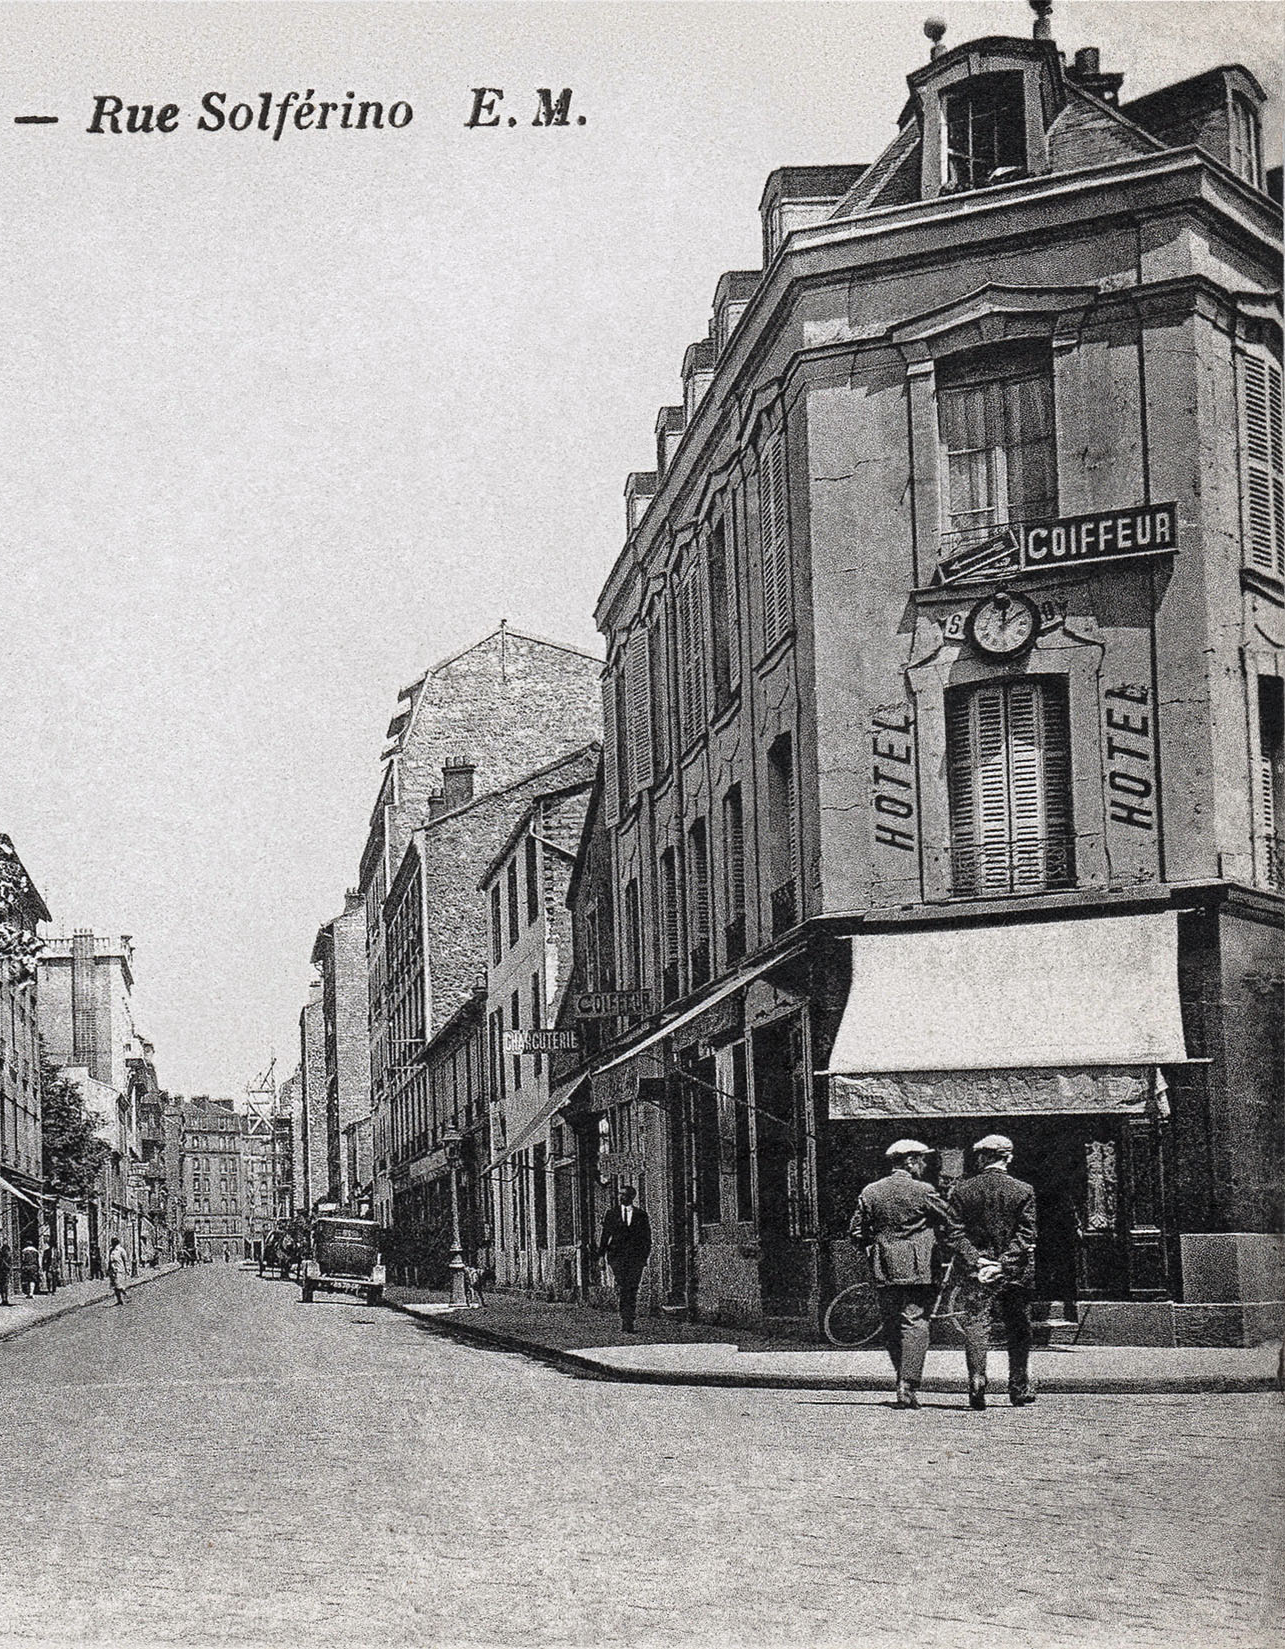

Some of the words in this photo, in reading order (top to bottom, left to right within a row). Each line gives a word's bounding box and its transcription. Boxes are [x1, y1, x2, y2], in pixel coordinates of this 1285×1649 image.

[1027, 511, 1172, 560] COIFFEUR
[871, 712, 916, 852] HOTEL
[1107, 682, 1154, 832] HOTEL
[503, 1030, 579, 1052] CHARCUTERIE
